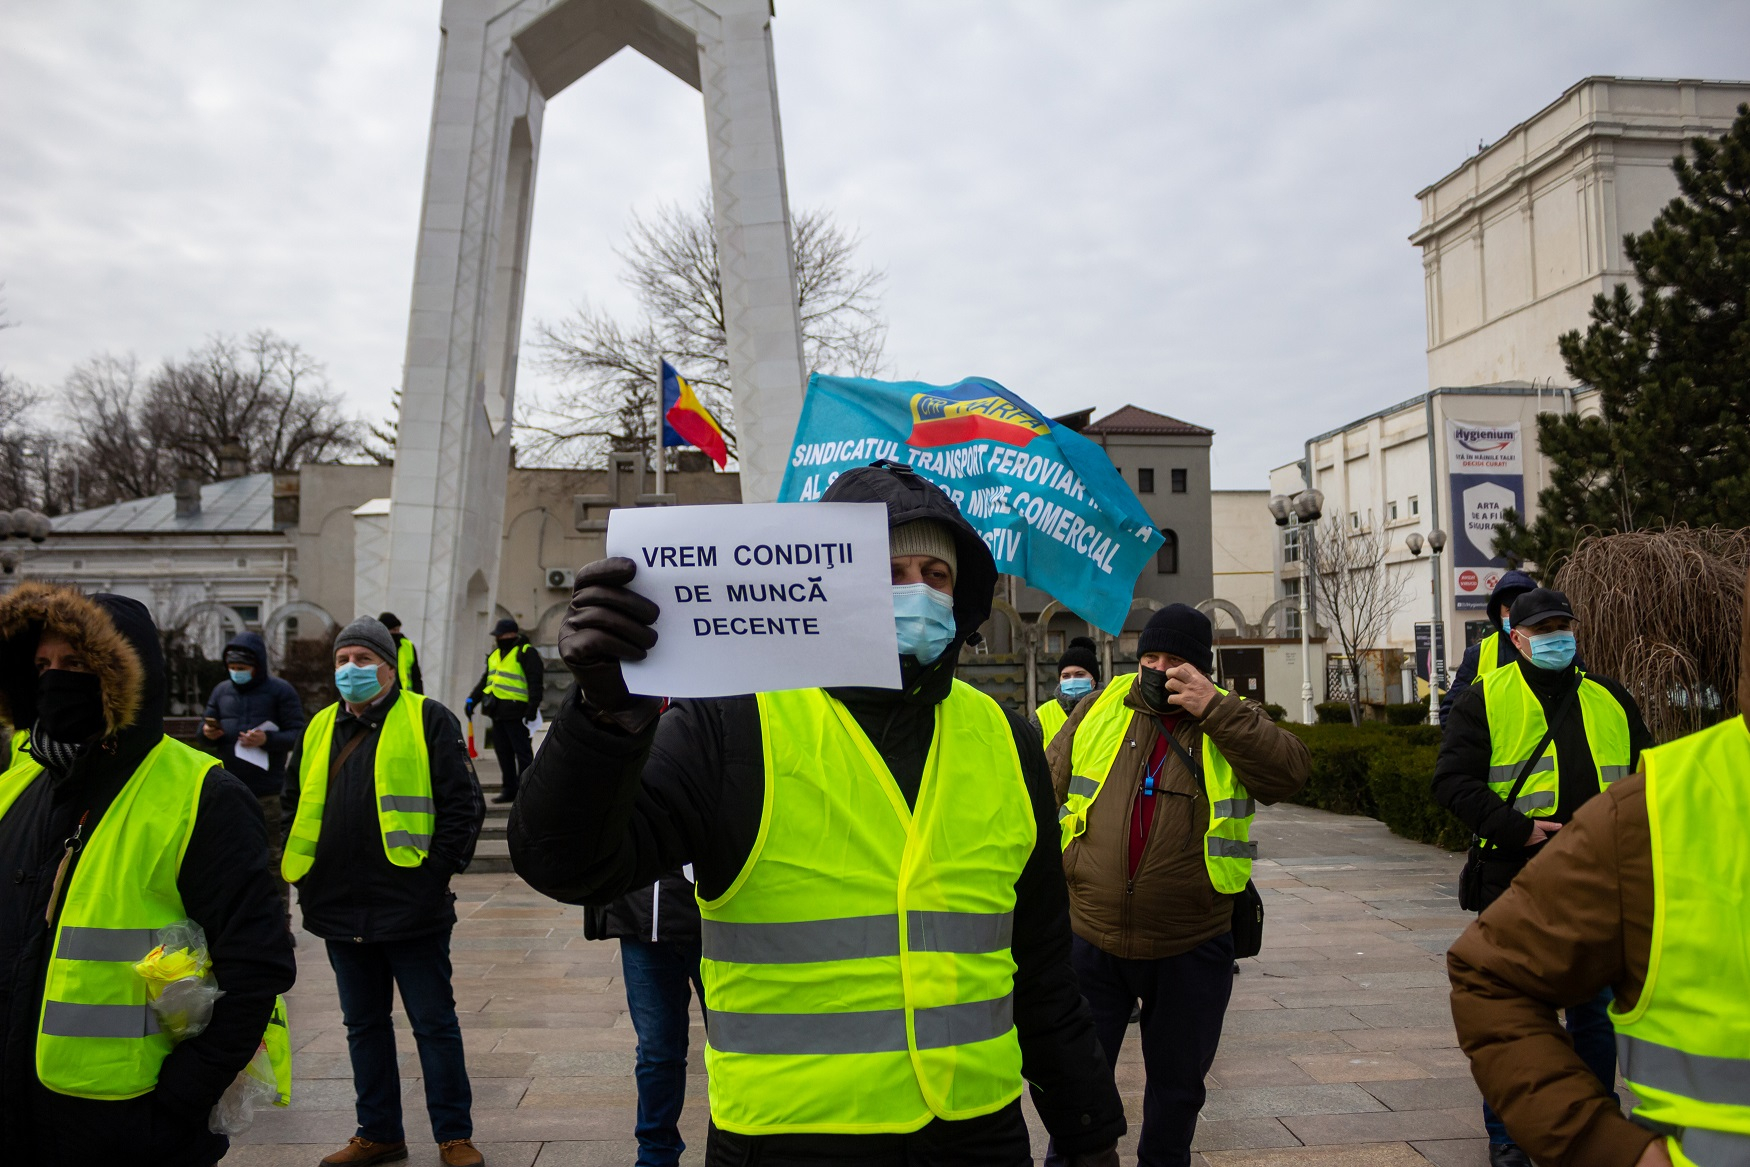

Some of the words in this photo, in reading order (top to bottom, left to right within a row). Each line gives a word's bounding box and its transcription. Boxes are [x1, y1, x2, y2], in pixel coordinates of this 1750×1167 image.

[1455, 428, 1514, 441] Hygienium
[792, 437, 900, 467] SINDICATUL
[907, 444, 989, 479] TRANSPORT
[799, 474, 821, 502] AL
[1013, 491, 1123, 575] COMERCIAL
[1482, 512, 1488, 520] A
[1490, 512, 1498, 520] FI
[642, 546, 718, 568] VREM
[675, 585, 712, 603] DE
[726, 576, 828, 603] MUNCĂ
[693, 617, 820, 637] DECENTE
